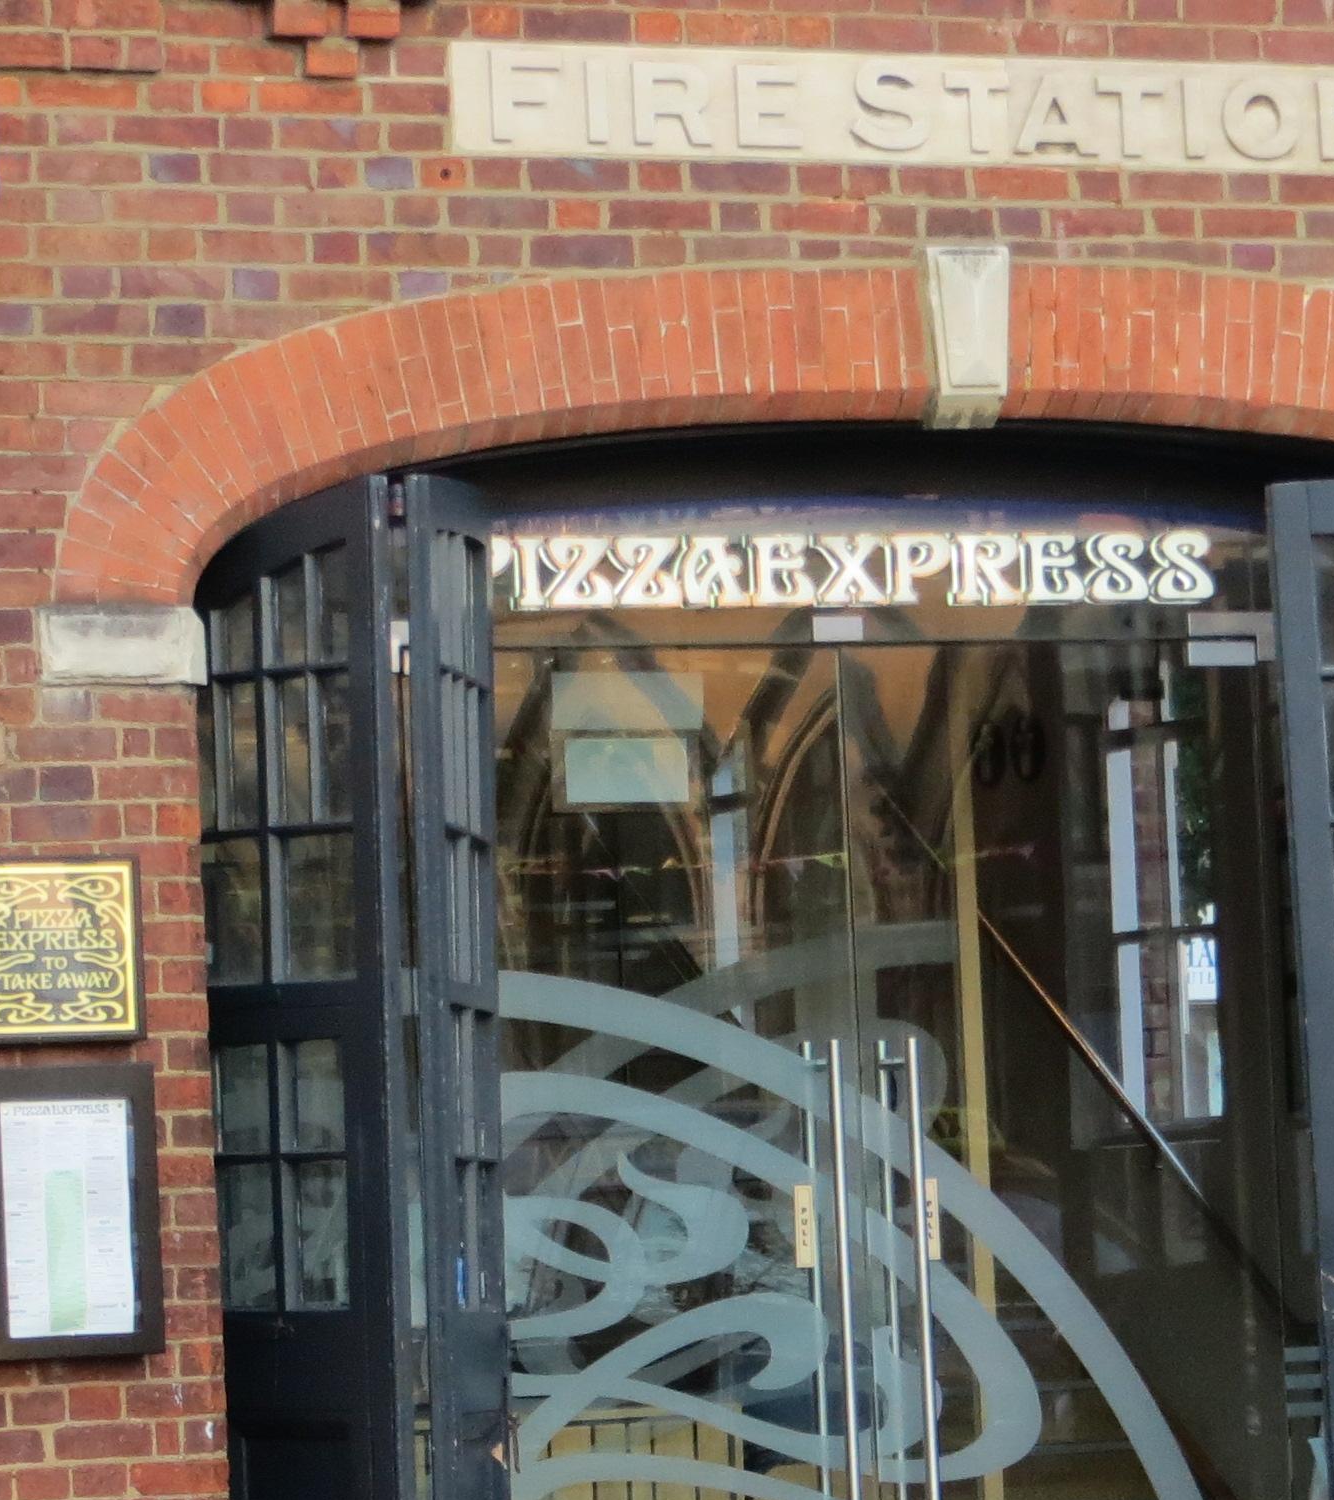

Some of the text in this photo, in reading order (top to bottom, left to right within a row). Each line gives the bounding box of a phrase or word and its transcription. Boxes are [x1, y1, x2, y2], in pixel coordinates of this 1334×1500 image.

[488, 48, 806, 152] FIRE
[13, 907, 94, 930] PIZZA
[41, 956, 67, 970] TO
[56, 971, 114, 989] AWAY
[800, 1207, 808, 1247] PULL
